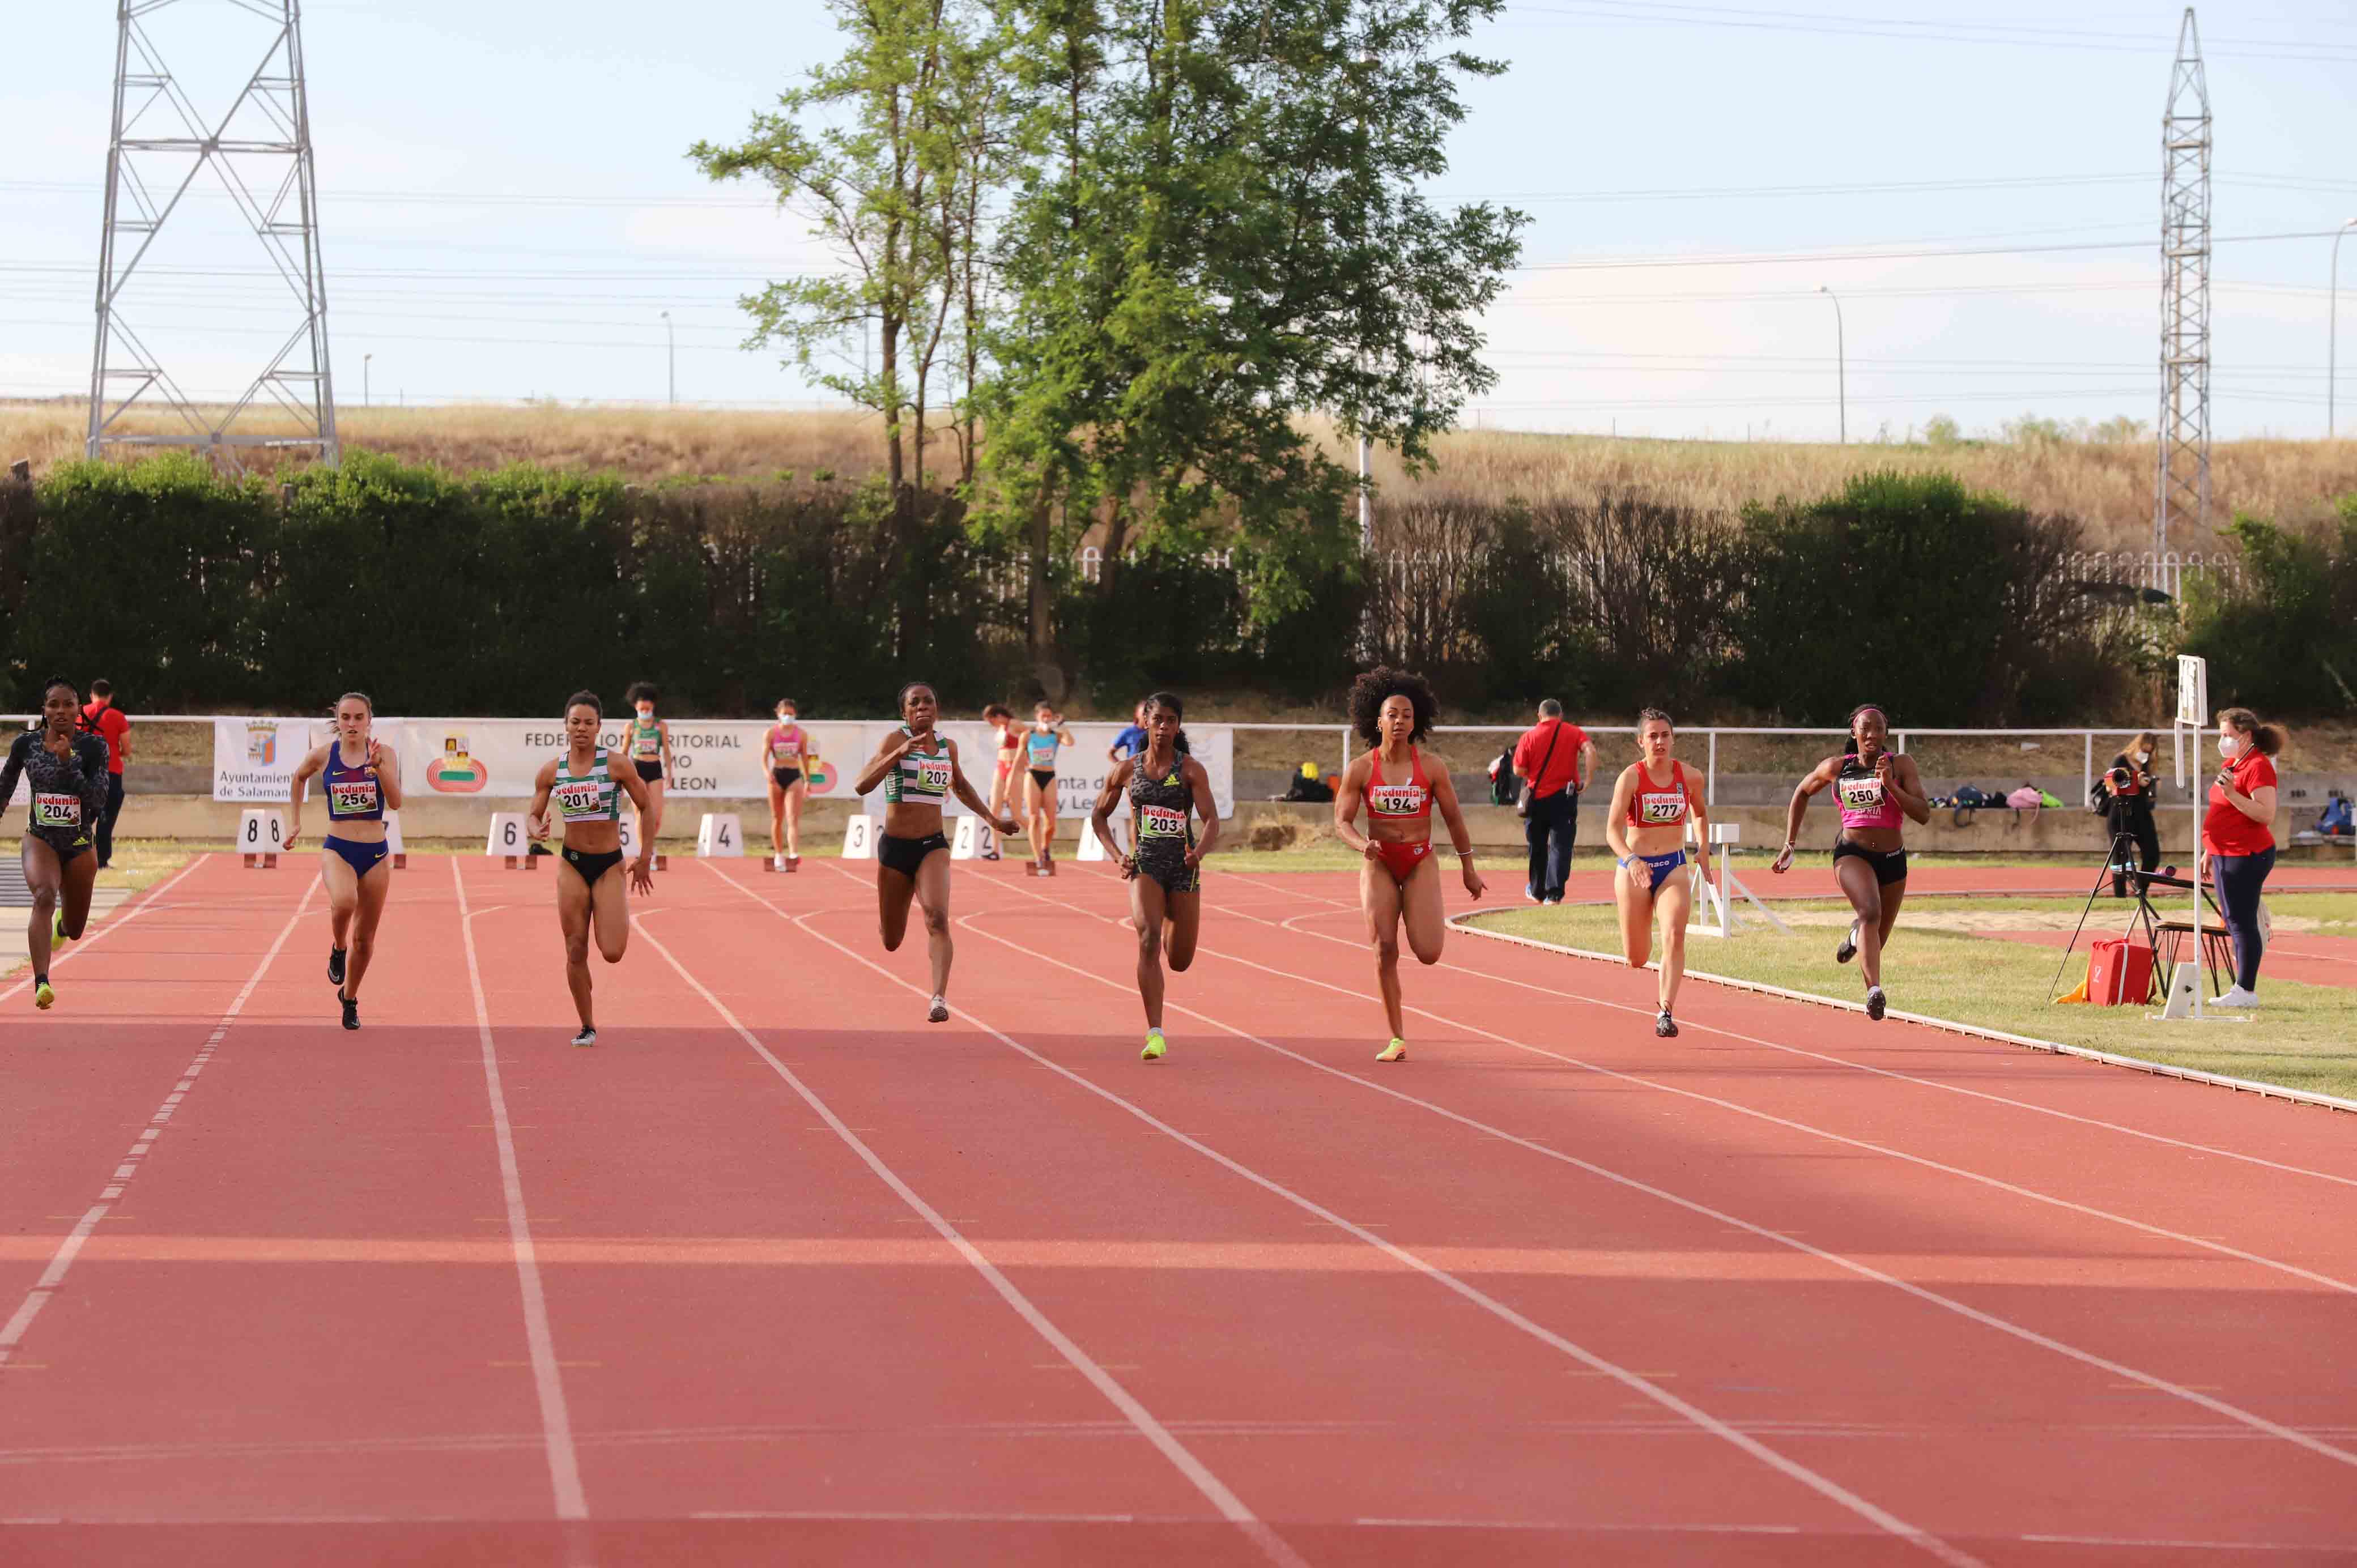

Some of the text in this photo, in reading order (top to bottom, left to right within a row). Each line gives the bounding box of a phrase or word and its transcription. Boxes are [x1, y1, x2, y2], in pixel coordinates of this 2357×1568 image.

[219, 771, 293, 784] Ayuntamien
[926, 771, 947, 785] 202
[1094, 776, 1105, 789] d
[219, 786, 291, 796] de Salaman
[333, 784, 375, 794] bedunia
[1375, 788, 1419, 797] bedunia
[1841, 781, 1879, 791] bedunia
[36, 796, 80, 804] bedunia
[341, 794, 368, 806] 256
[564, 793, 589, 807] 201
[1644, 796, 1685, 804] bedunia
[1849, 790, 1874, 803] 250
[1384, 798, 1411, 810] 194
[1652, 804, 1678, 817] 277
[44, 805, 71, 819] 204
[248, 819, 279, 842] 8 8
[1150, 817, 1177, 832] 203
[504, 822, 517, 846] 6
[620, 823, 629, 846] 5
[718, 824, 730, 847] 4
[854, 825, 863, 847] 3
[961, 826, 991, 850] 2 2
